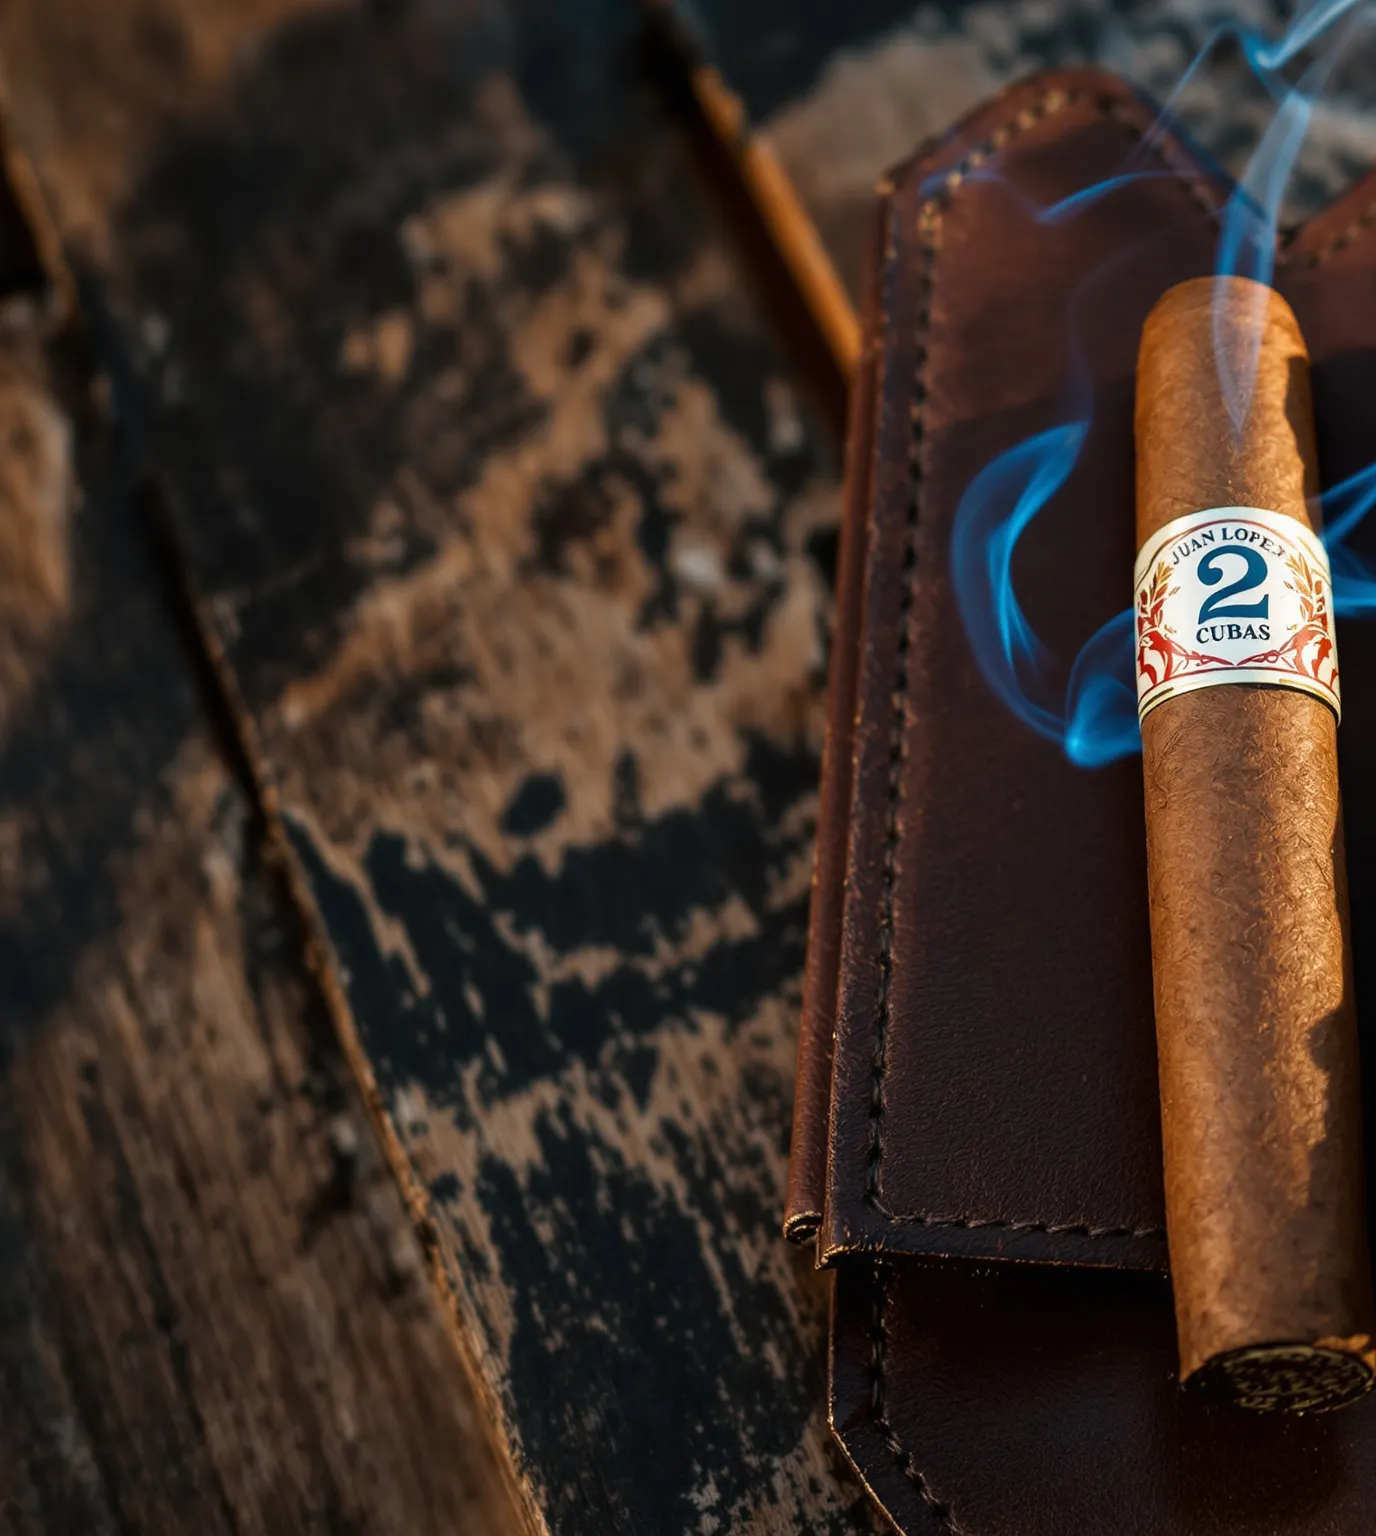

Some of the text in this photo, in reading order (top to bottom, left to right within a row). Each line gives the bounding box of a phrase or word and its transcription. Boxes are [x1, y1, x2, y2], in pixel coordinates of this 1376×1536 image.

[1172, 530, 1216, 565] JUAN
[1197, 544, 1269, 625] 2
[1196, 623, 1271, 644] CUBAS
